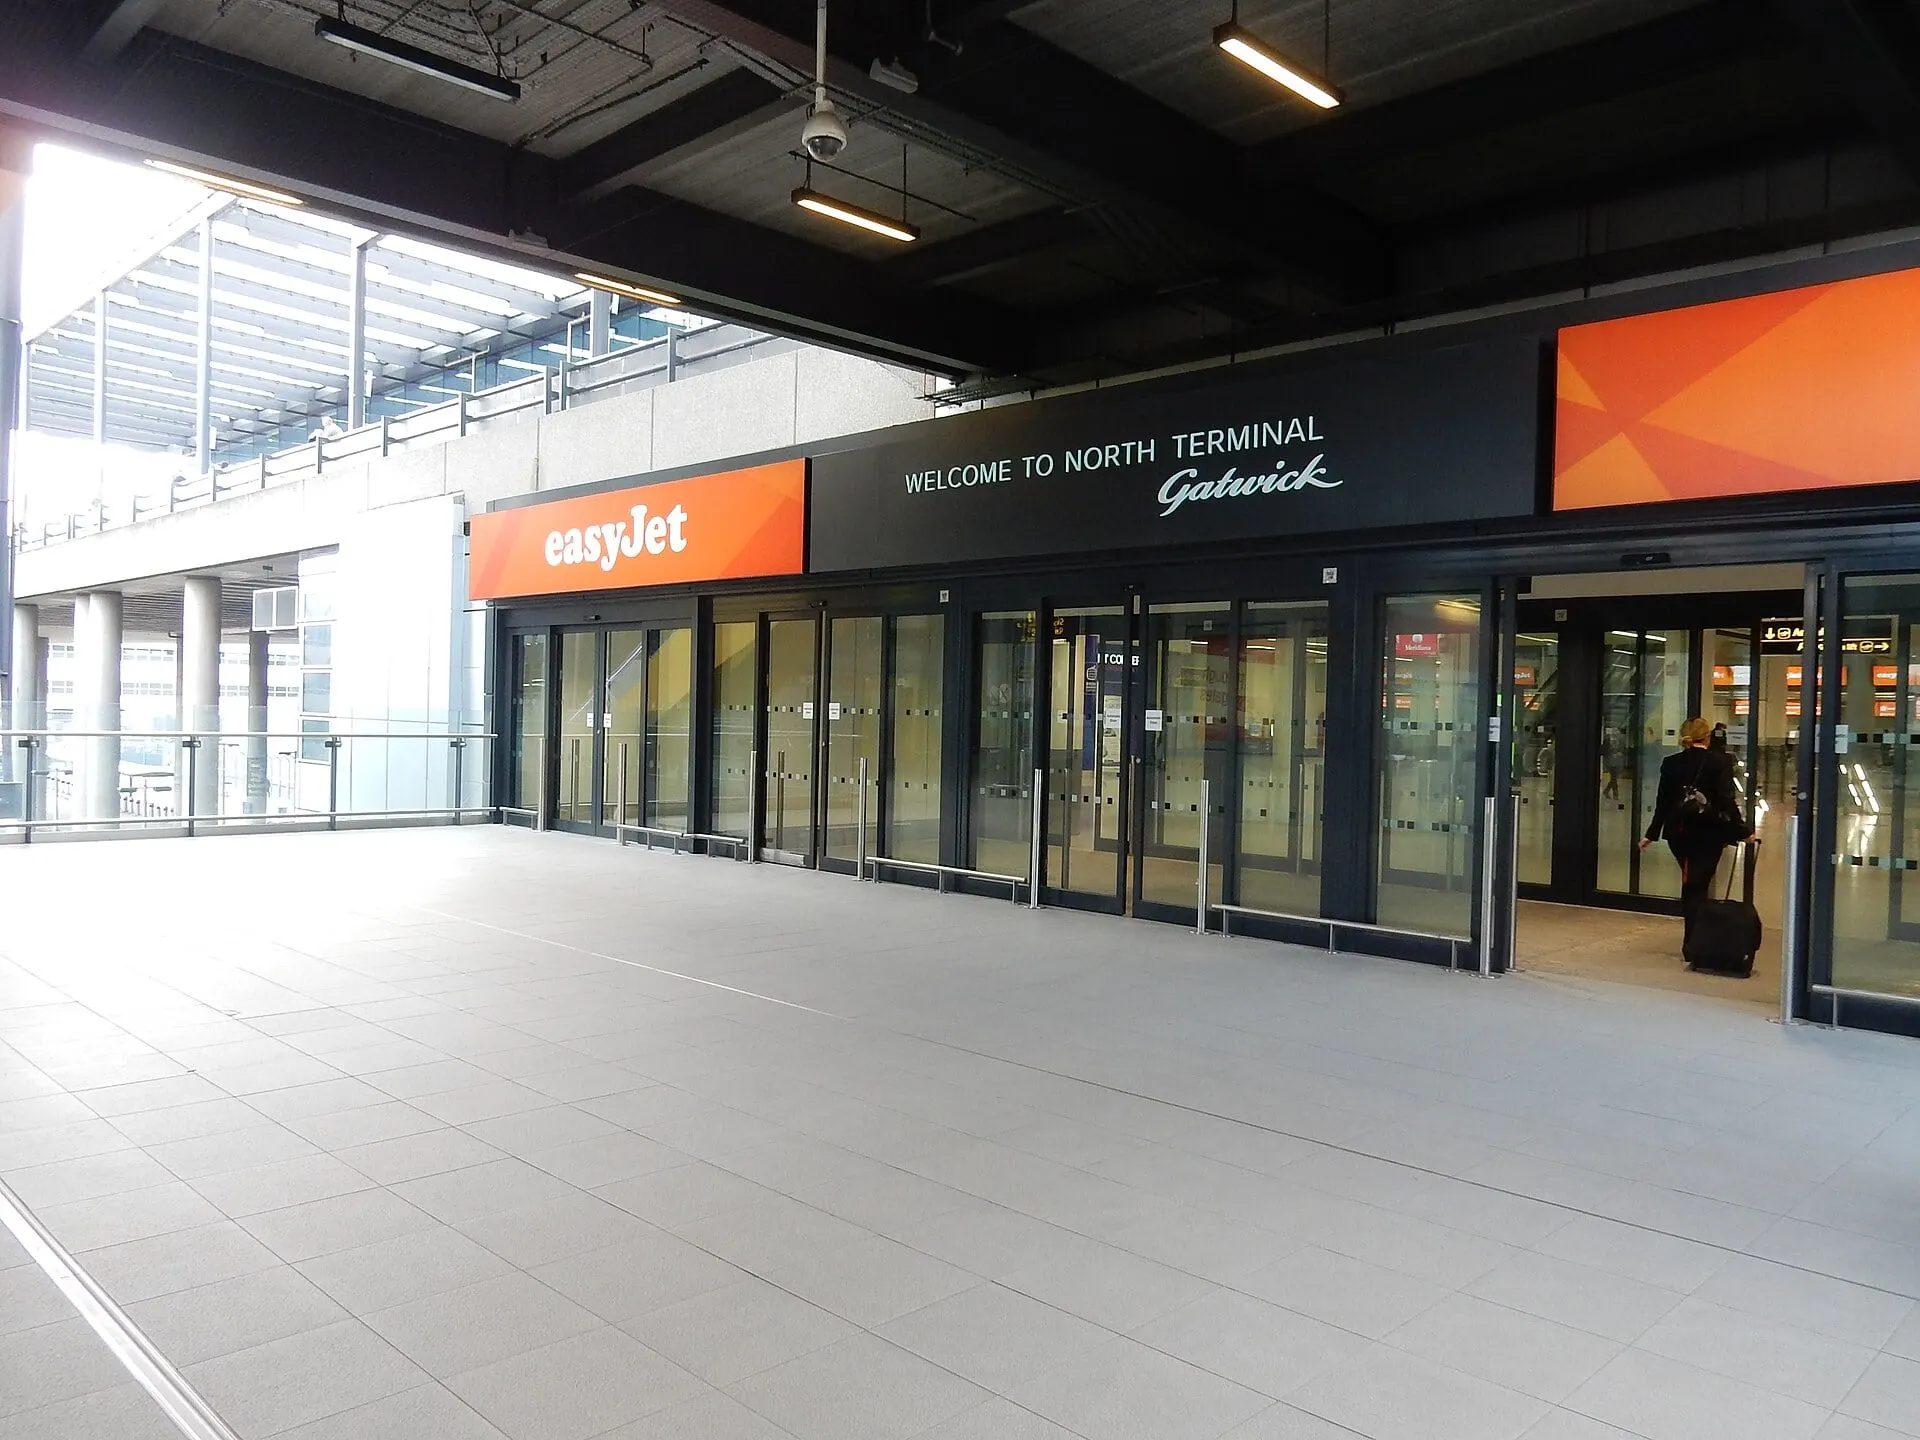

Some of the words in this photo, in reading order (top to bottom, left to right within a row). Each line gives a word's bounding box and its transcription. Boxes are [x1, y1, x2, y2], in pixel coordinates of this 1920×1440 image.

[905, 460, 1012, 494] WELCOME
[1021, 454, 1054, 478] TO
[1065, 439, 1155, 473] NORTH
[1172, 416, 1324, 459] TERMINAL
[1158, 454, 1344, 517] Gatwick
[544, 503, 688, 572] easyJet
